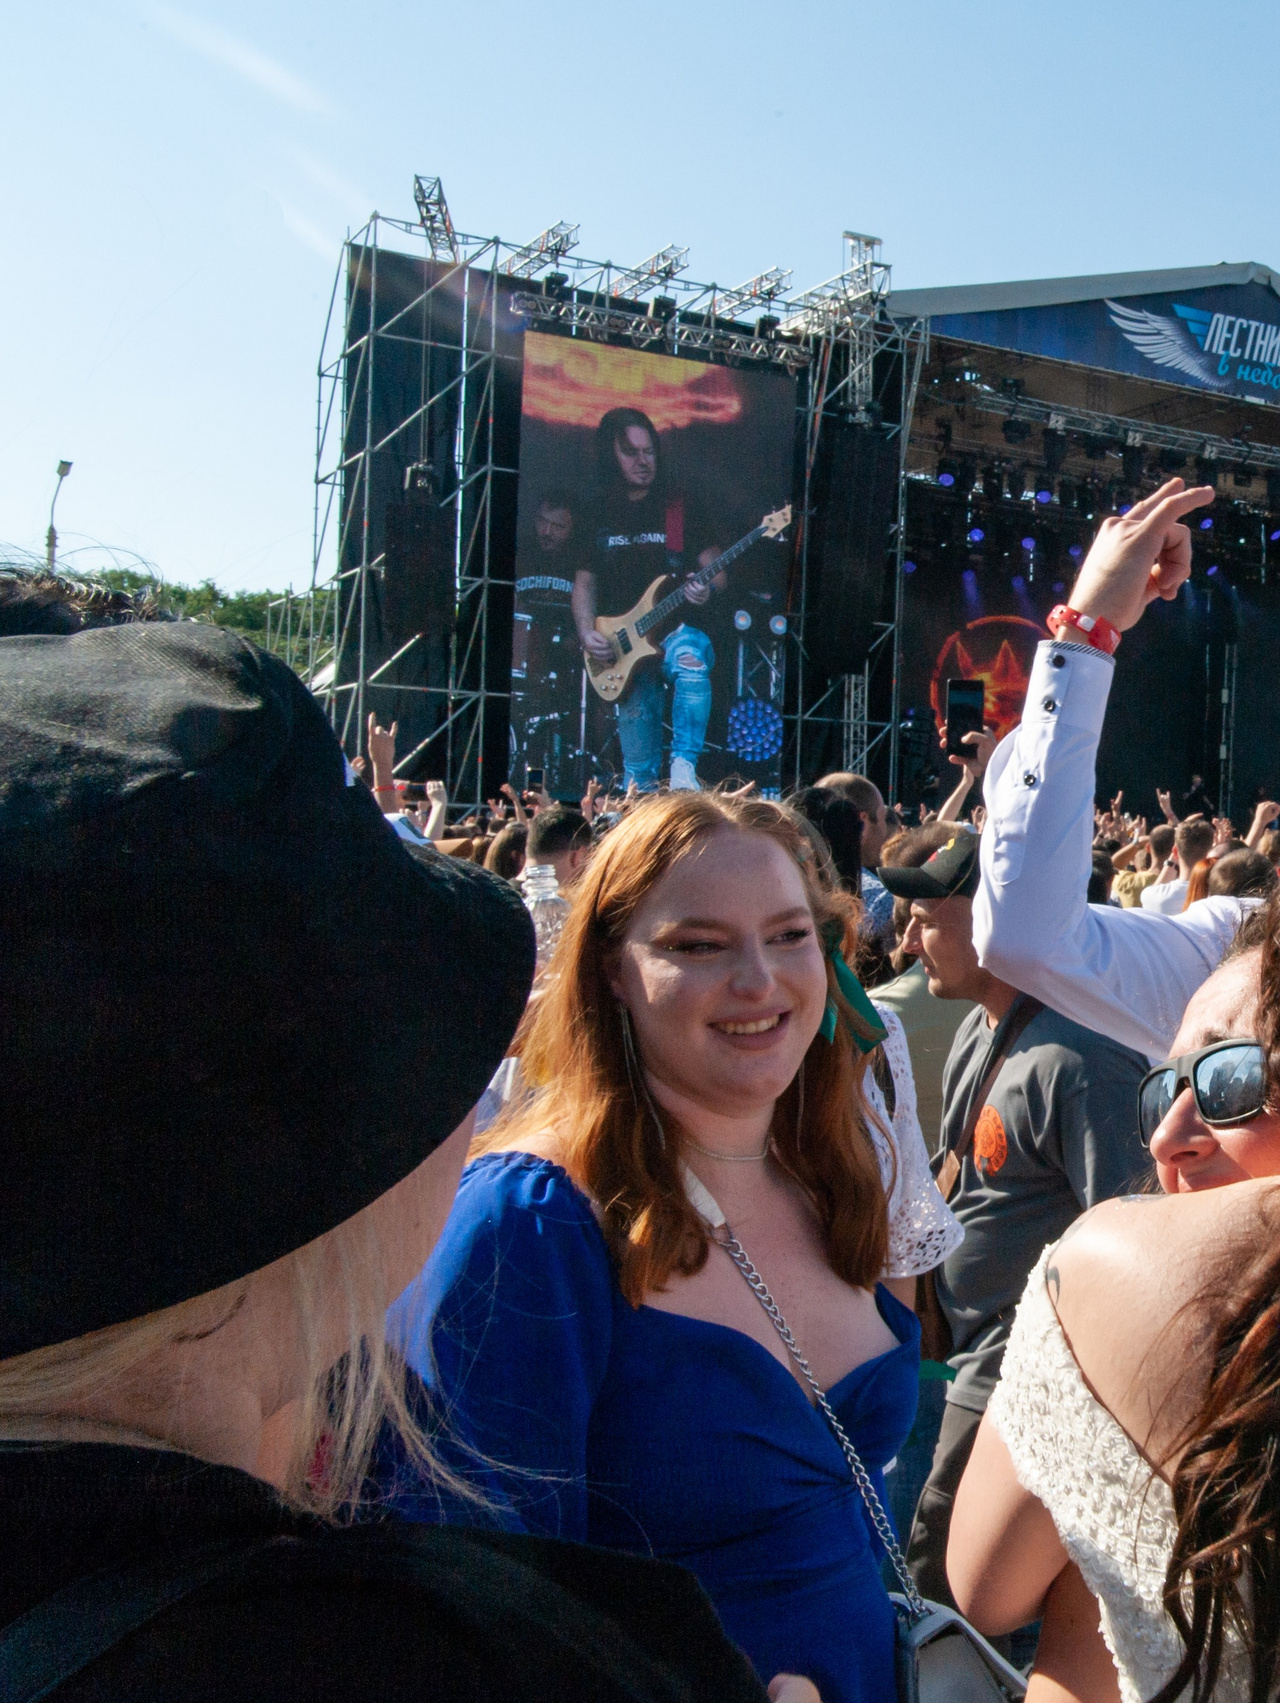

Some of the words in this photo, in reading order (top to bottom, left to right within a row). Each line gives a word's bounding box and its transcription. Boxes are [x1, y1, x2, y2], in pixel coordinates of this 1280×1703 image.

[1217, 350, 1230, 377] в
[633, 532, 666, 544] AGAIN
[515, 575, 574, 593] SOCHIFORN
